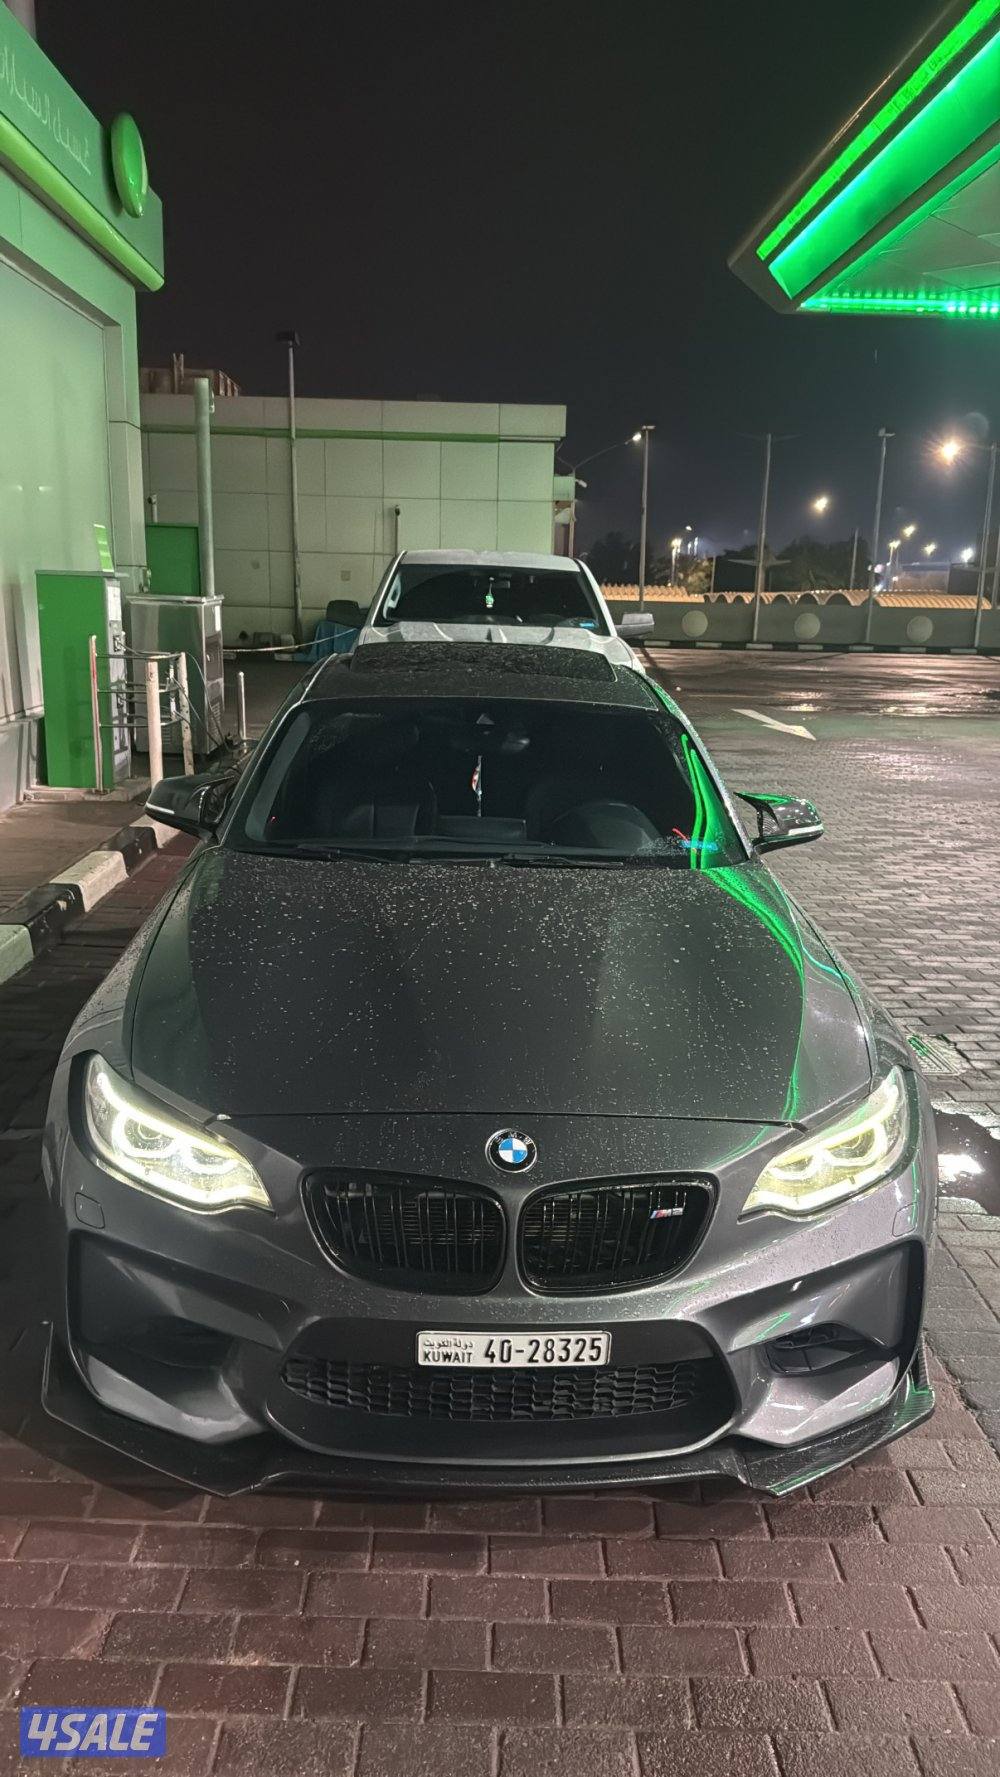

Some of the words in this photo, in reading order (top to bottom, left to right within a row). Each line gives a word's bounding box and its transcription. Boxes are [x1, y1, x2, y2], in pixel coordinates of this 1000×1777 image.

[423, 1338, 452, 1350] الكويت
[453, 1337, 474, 1350] دولة
[423, 1351, 473, 1363] KUWAIT
[484, 1338, 603, 1364] 40-28325
